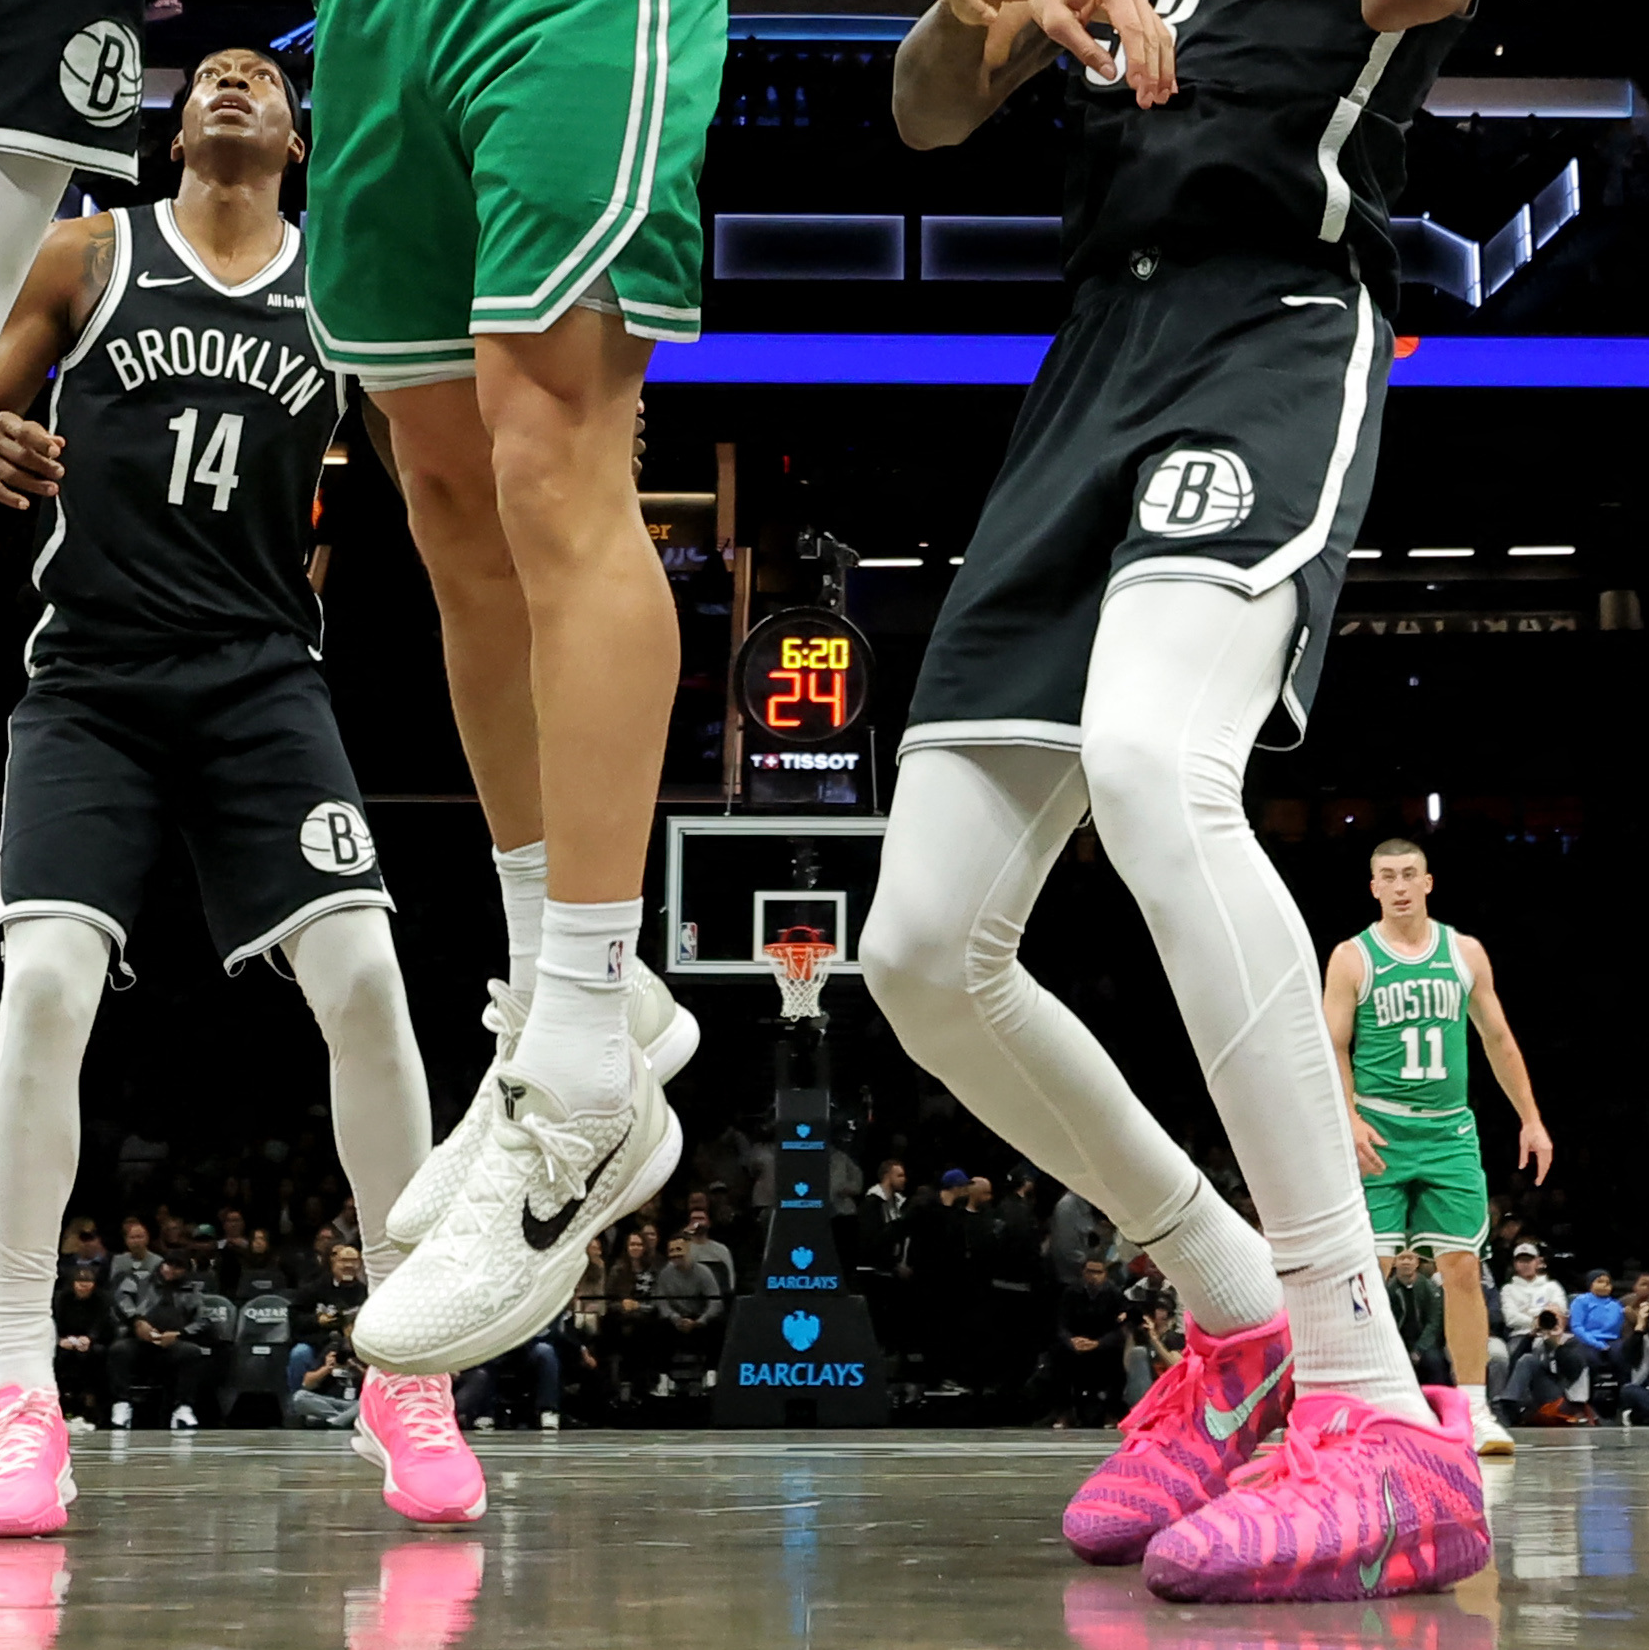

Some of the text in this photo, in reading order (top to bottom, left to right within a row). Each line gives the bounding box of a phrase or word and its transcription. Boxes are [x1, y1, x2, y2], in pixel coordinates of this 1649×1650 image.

[267, 292, 281, 308] All
[283, 294, 294, 308] In
[106, 326, 326, 417] BROOKLYN
[168, 407, 244, 512] 14
[781, 638, 850, 670] 6:20
[766, 670, 846, 728] 24
[779, 753, 860, 770] TISSOT
[1373, 978, 1461, 1028] BOSTON
[1400, 1026, 1448, 1080] 11
[766, 1276, 838, 1290] BARCLAYS
[739, 1363, 864, 1387] BARCLAYS
